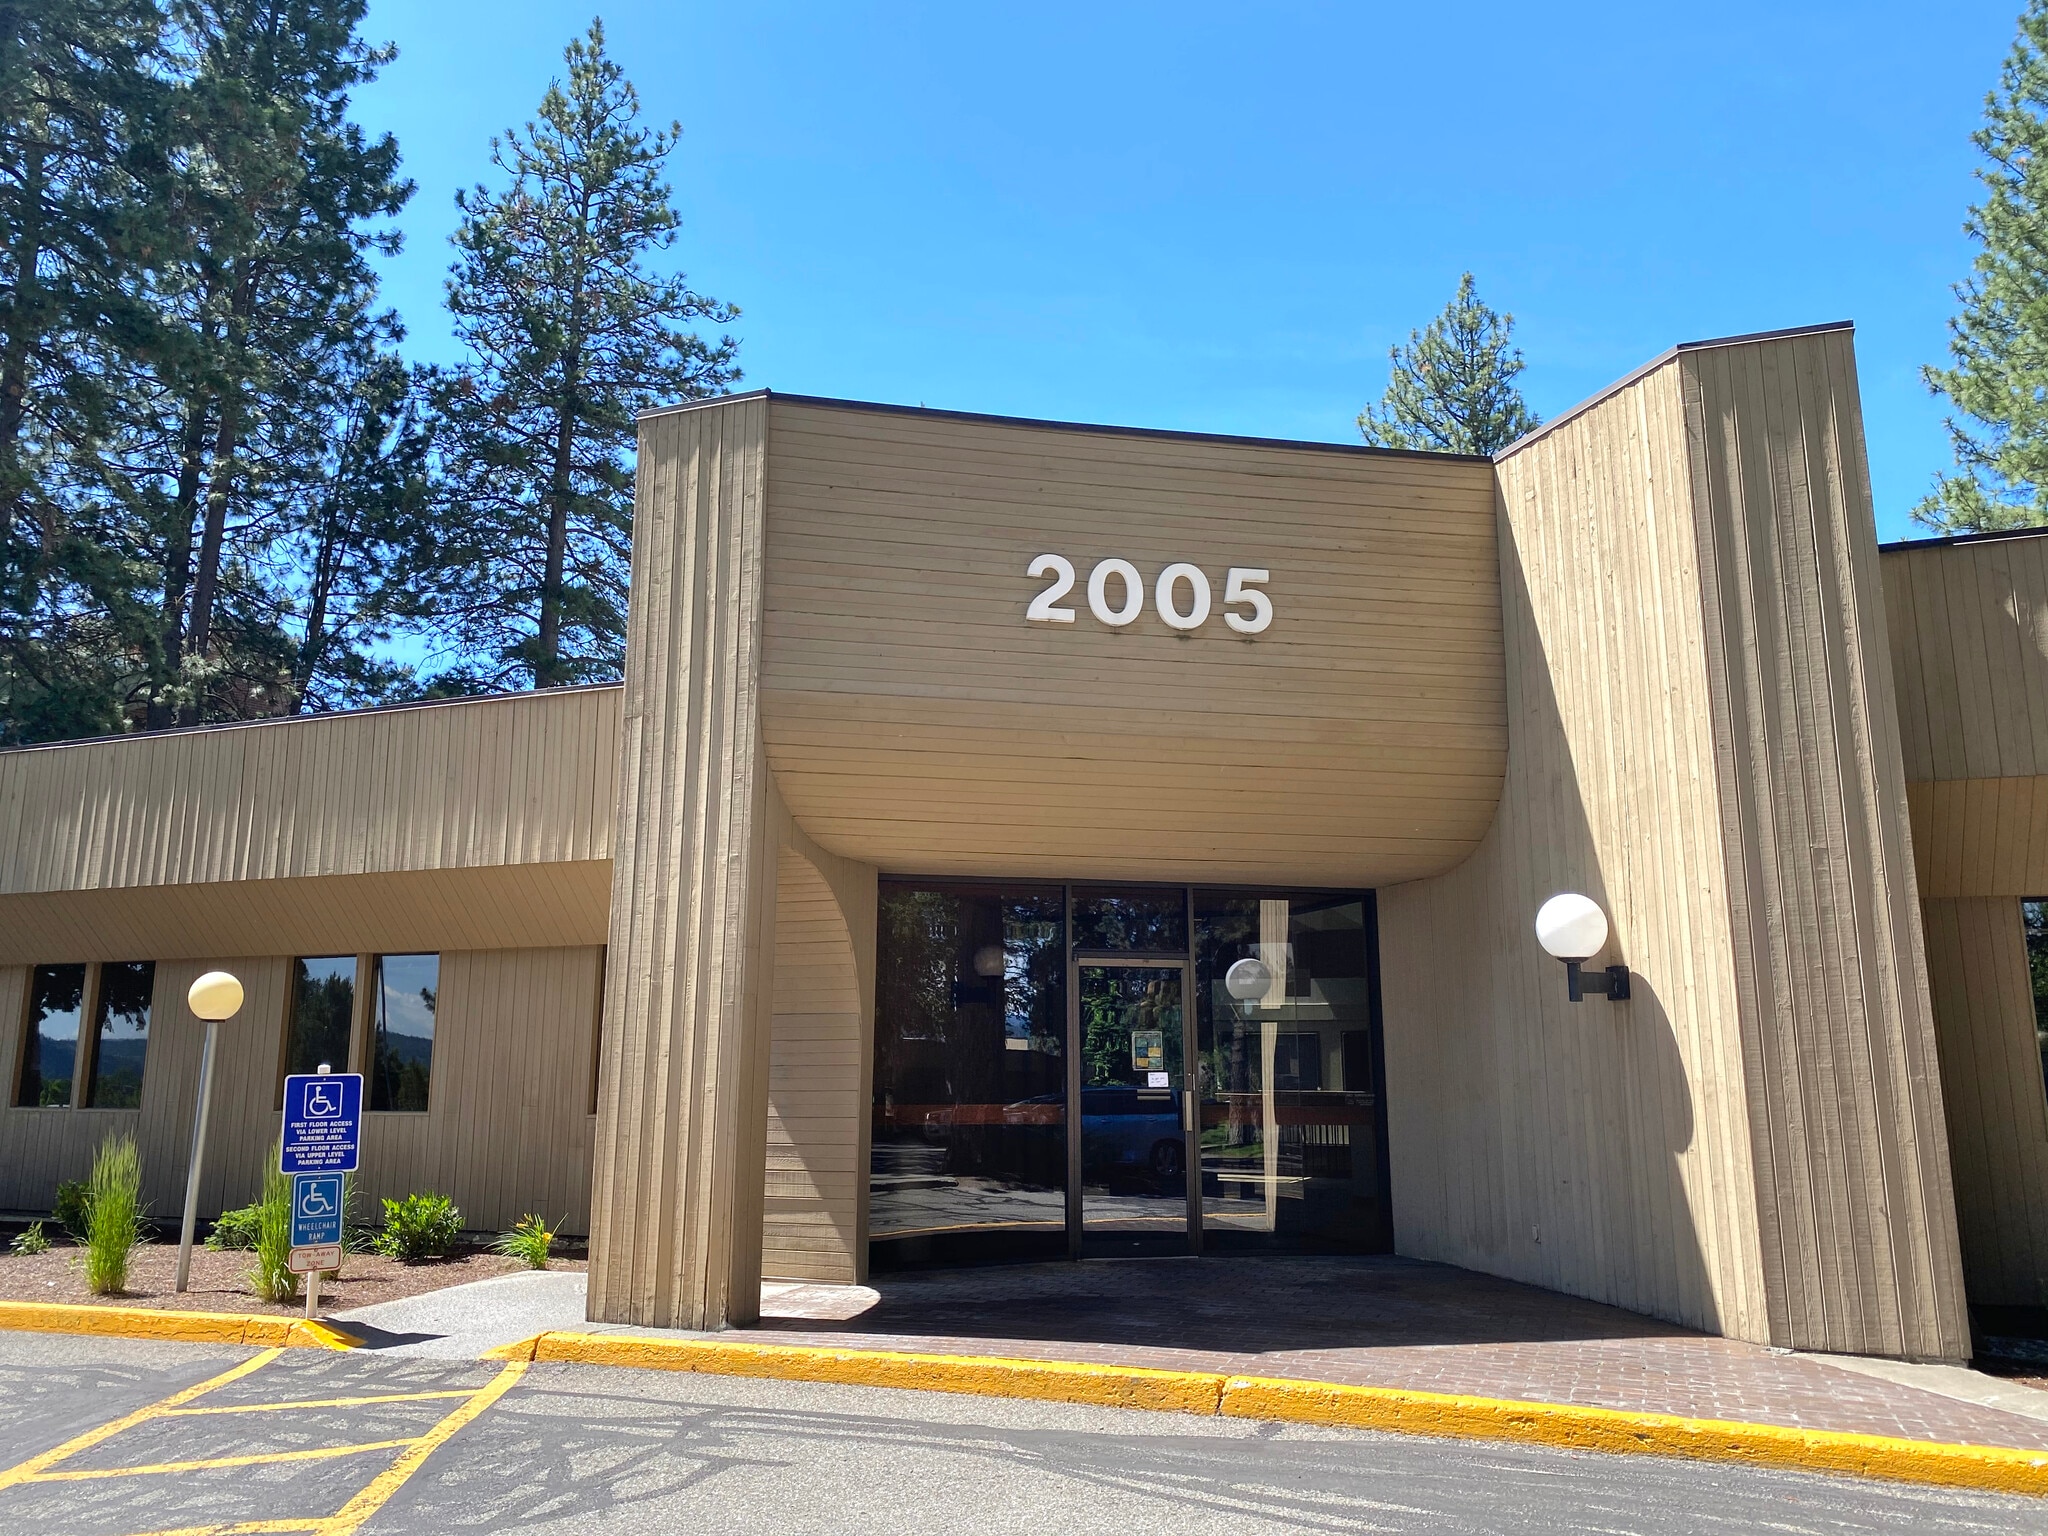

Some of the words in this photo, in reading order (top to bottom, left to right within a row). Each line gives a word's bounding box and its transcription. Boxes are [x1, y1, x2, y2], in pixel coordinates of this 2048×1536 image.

[1026, 553, 1273, 634] 2005
[298, 1221, 336, 1231] WHEELCHAIR
[308, 1232, 325, 1240] RAMP
